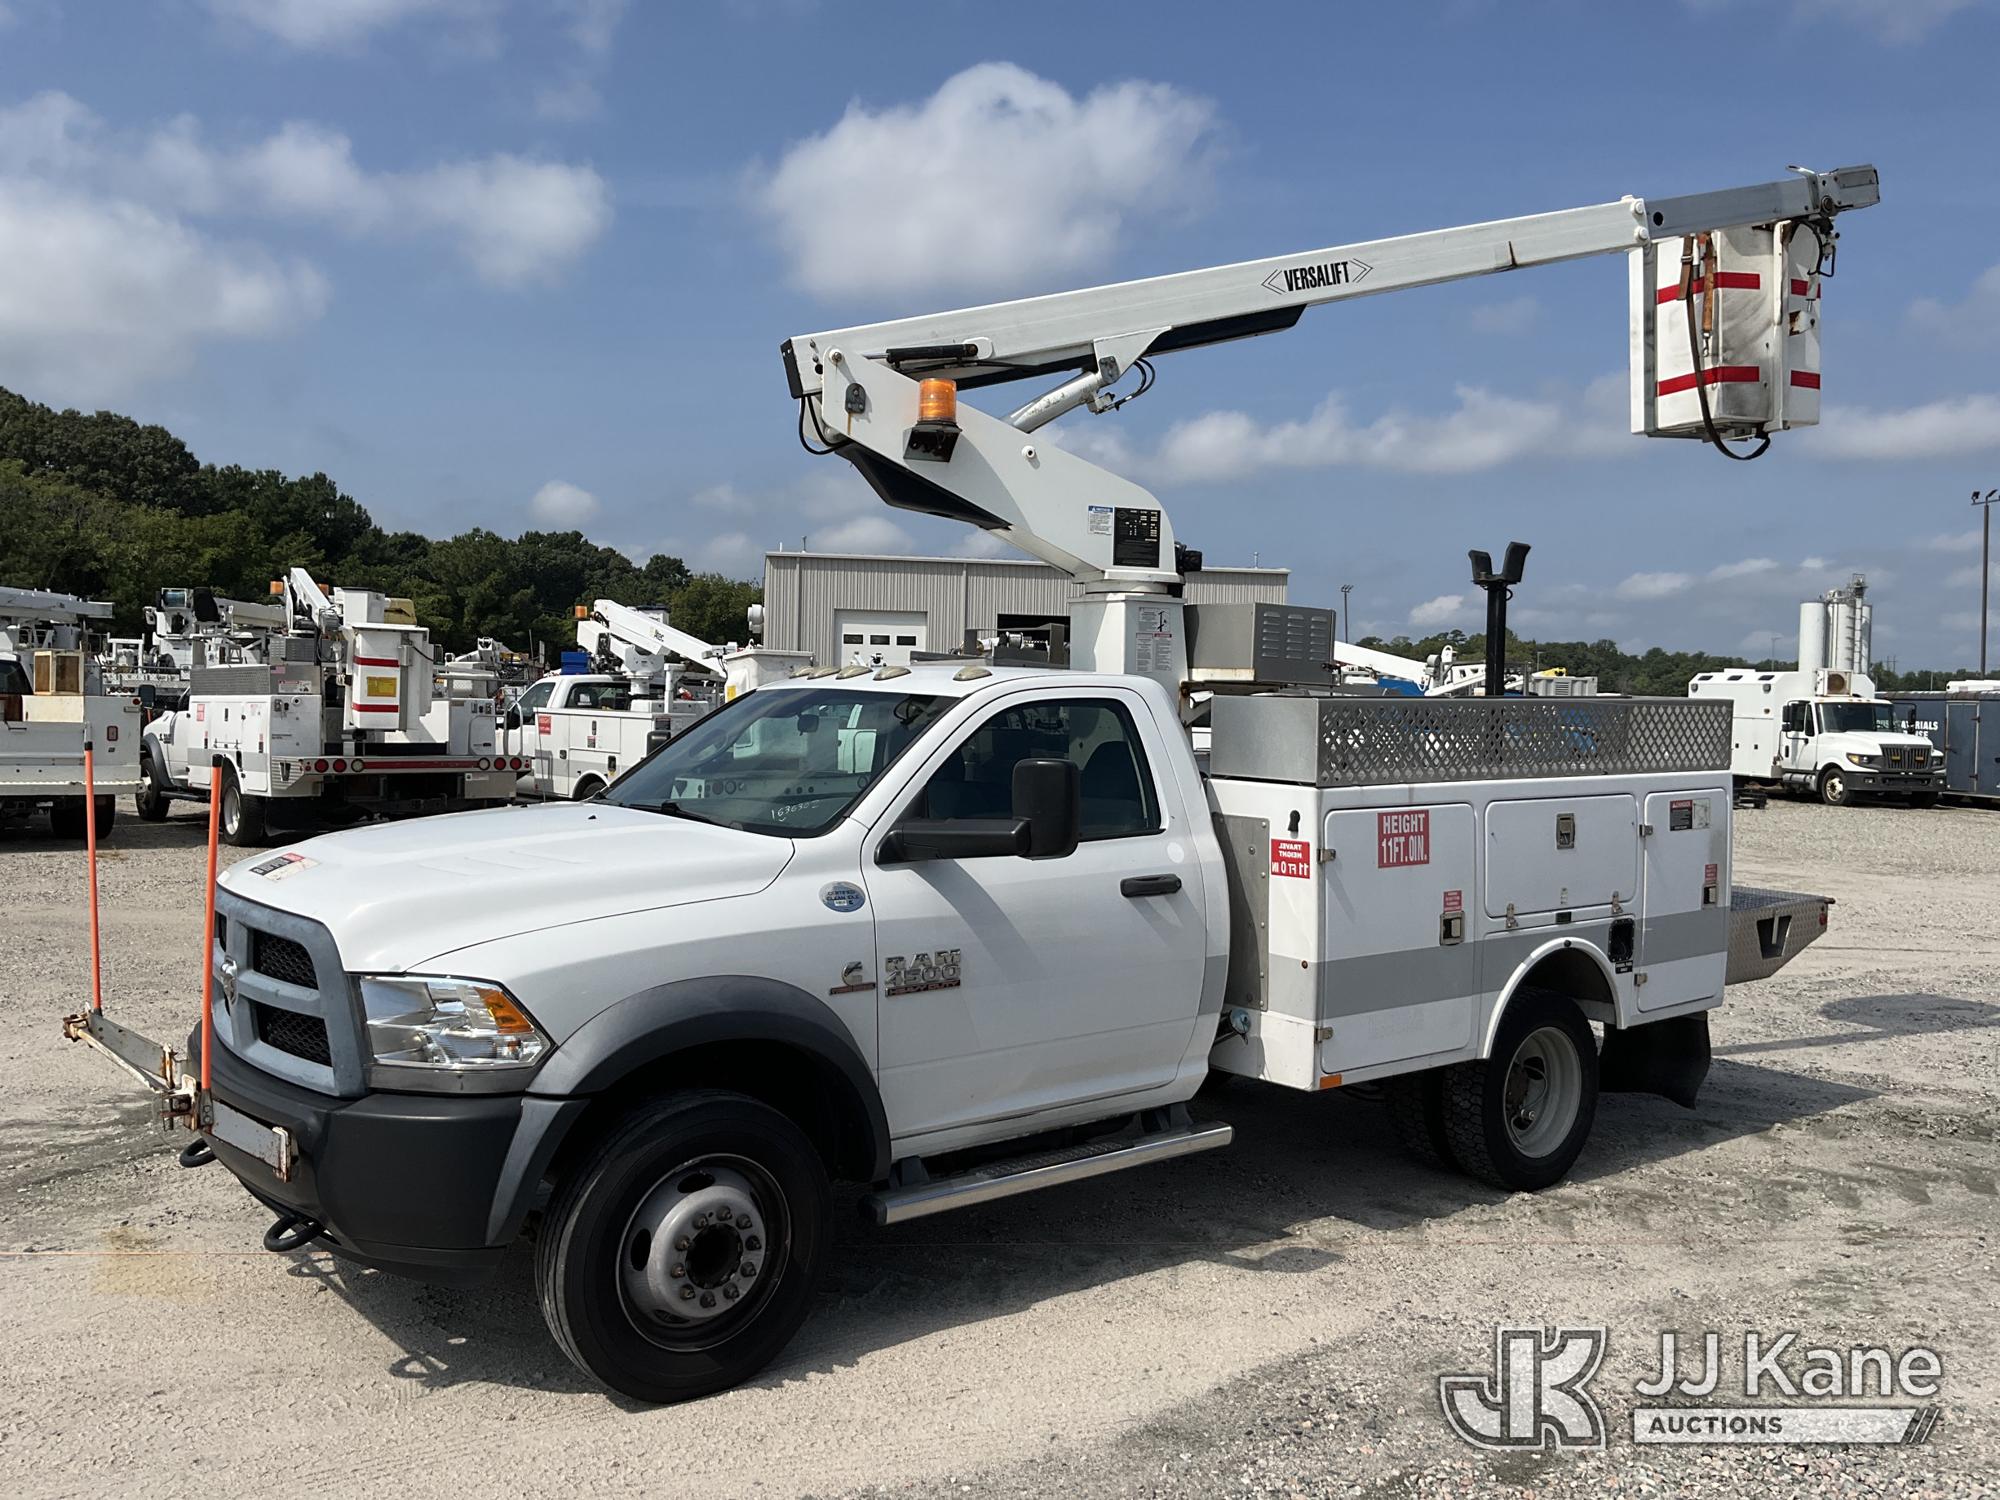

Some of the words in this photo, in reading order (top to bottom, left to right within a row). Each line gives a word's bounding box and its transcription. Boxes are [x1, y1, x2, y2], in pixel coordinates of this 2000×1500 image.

[1284, 261, 1350, 292] VERSALIFT
[1383, 813, 1425, 835] HEIGHT
[885, 949, 961, 973] RAM
[884, 963, 961, 987] 4500
